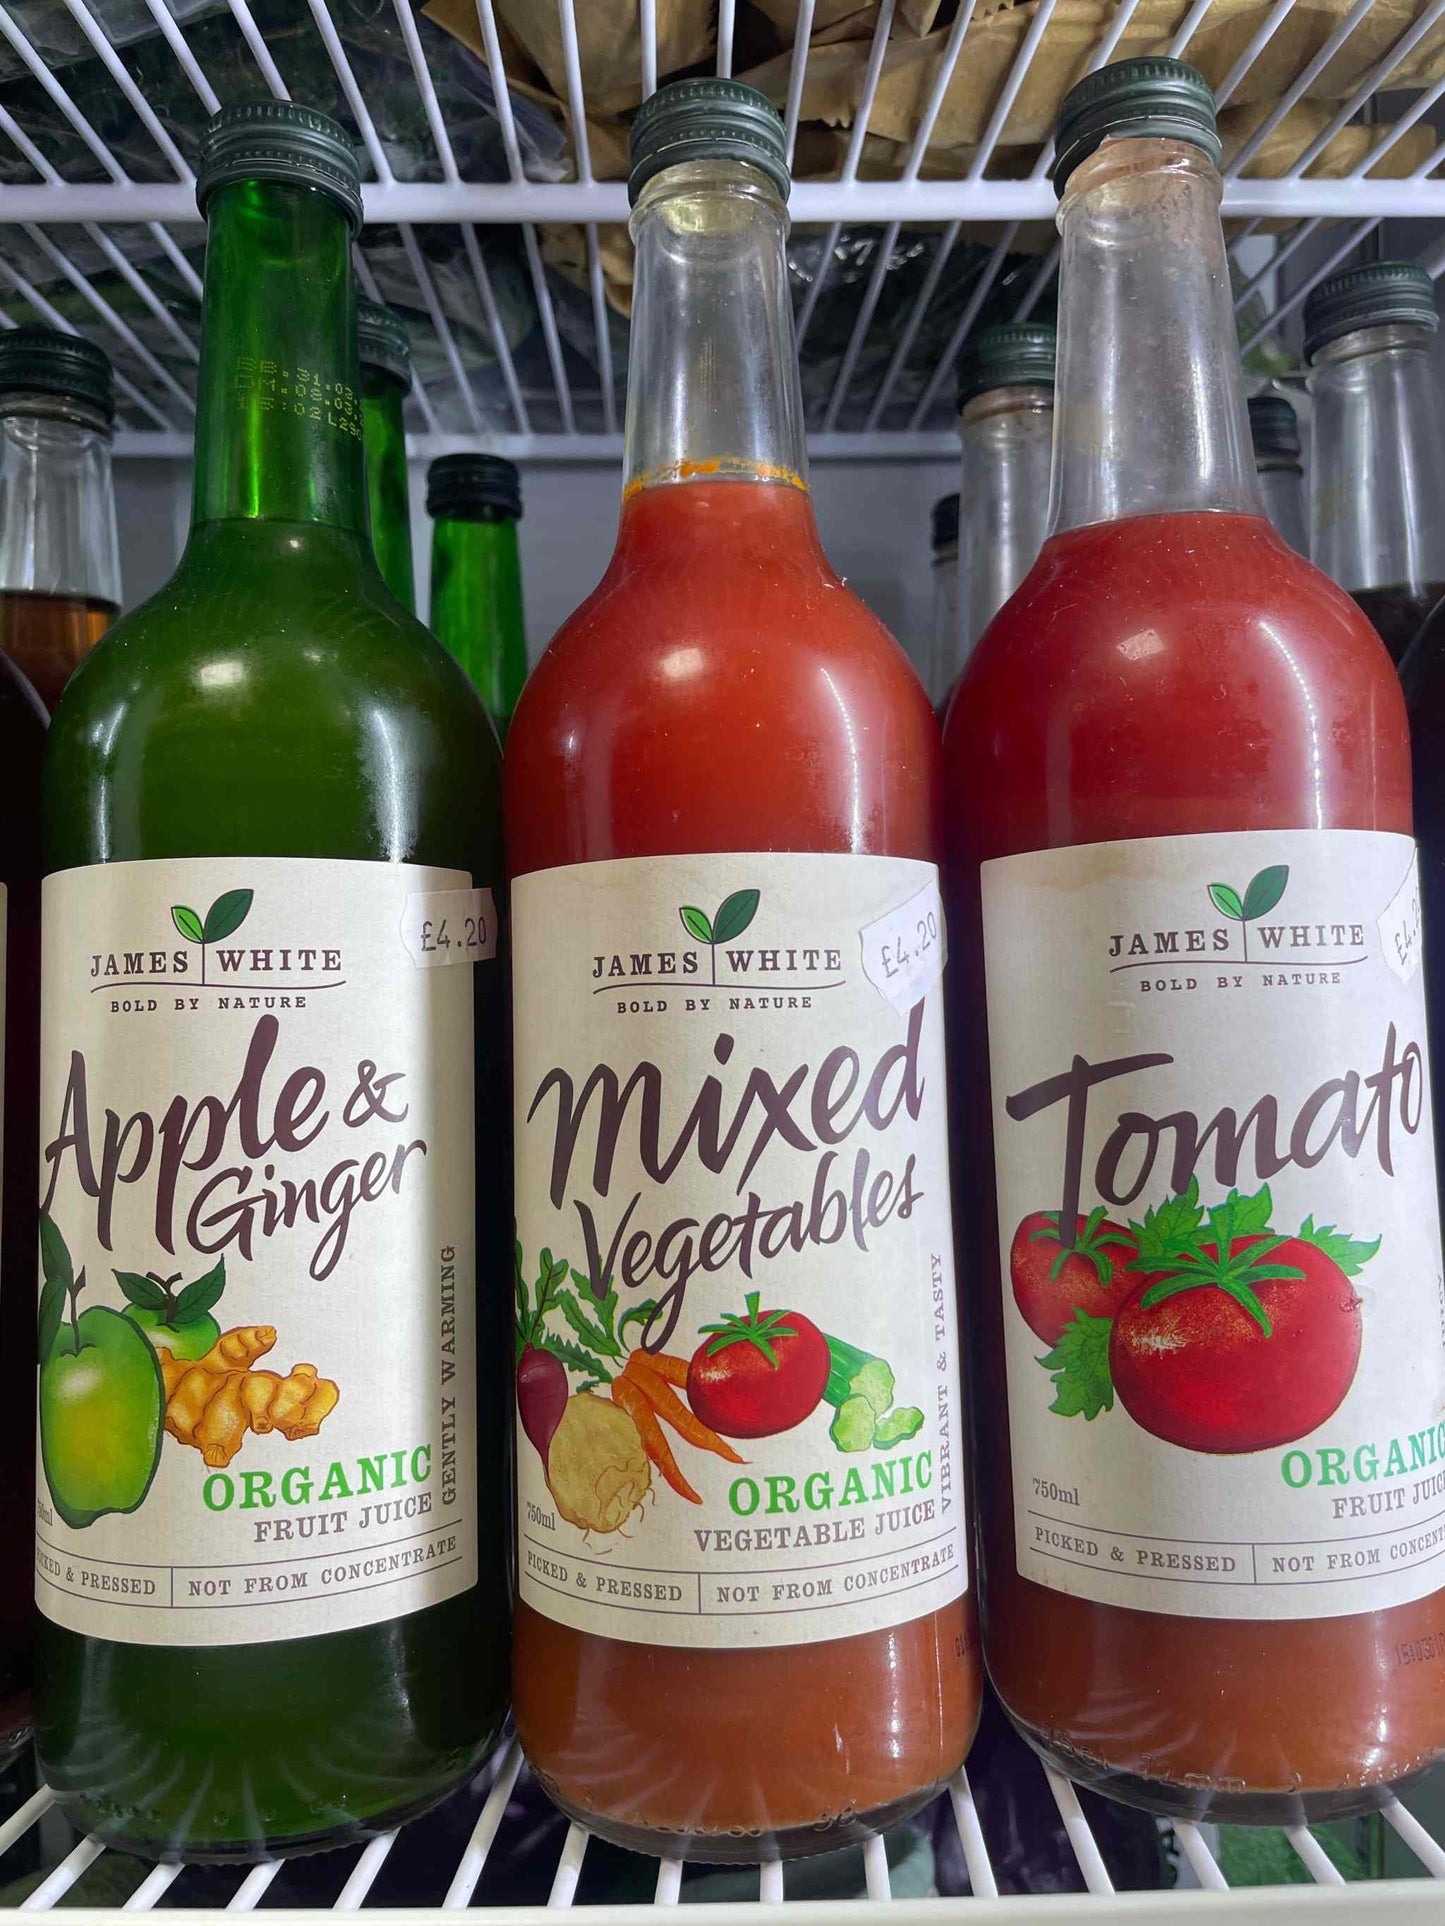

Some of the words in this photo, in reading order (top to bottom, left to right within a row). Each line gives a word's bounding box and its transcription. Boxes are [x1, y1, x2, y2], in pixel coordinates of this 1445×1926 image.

[420, 917, 487, 952] £4.20
[880, 911, 938, 979] £4.20
[1109, 928, 1230, 957] JAMES
[1257, 924, 1365, 949] WHITE
[90, 950, 189, 977] JAMES
[216, 949, 341, 972] WHITE
[592, 951, 699, 978] JAMES
[726, 949, 841, 972] WHITE
[1140, 978, 1198, 993] BOLD
[1217, 975, 1243, 988] BY
[1262, 972, 1341, 987] NATURE
[111, 999, 157, 1013] BOLD
[175, 998, 199, 1010] BY
[218, 996, 306, 1009] NATURE
[617, 1000, 668, 1014] BOLD
[685, 998, 711, 1011] BY
[729, 996, 812, 1010] NATURE
[40, 1014, 329, 1255] Apple
[342, 1059, 408, 1128] &
[1005, 1021, 1423, 1250] Tomato
[186, 1138, 427, 1282] Ginger
[573, 1147, 925, 1355] Vegetables
[440, 1245, 456, 1386] WARMING
[931, 1253, 947, 1341] TASTY
[936, 1353, 948, 1372] &
[441, 1396, 457, 1506] GENTLY
[936, 1384, 952, 1514] VIBRANT
[202, 1444, 432, 1511] ORGANIC
[728, 1450, 932, 1516] ORGANIC
[1032, 1477, 1079, 1507] 750ml
[253, 1511, 348, 1543] FRUIT
[358, 1492, 432, 1530] JUICE
[526, 1501, 555, 1532] 750ml
[694, 1517, 865, 1553] VEGETABLE
[874, 1499, 935, 1535] JUICE
[1332, 1488, 1405, 1519] FRUIT
[188, 1580, 231, 1596] NOT
[244, 1572, 308, 1593] FROM
[321, 1534, 457, 1585] CONCENTRATE
[527, 1549, 568, 1583] PICKED
[576, 1572, 587, 1588] &
[596, 1575, 682, 1601] PRESSED
[716, 1586, 759, 1602] NOT
[772, 1578, 832, 1599] FROM
[844, 1543, 954, 1591] CONCENTRATE
[1035, 1526, 1099, 1557] PICKED
[1110, 1546, 1125, 1562] &
[1136, 1548, 1236, 1573] PRESSED
[1271, 1556, 1315, 1572] NOT
[1327, 1547, 1381, 1569] FROM
[66, 1563, 75, 1583] &
[80, 1567, 157, 1596] PRESSED
